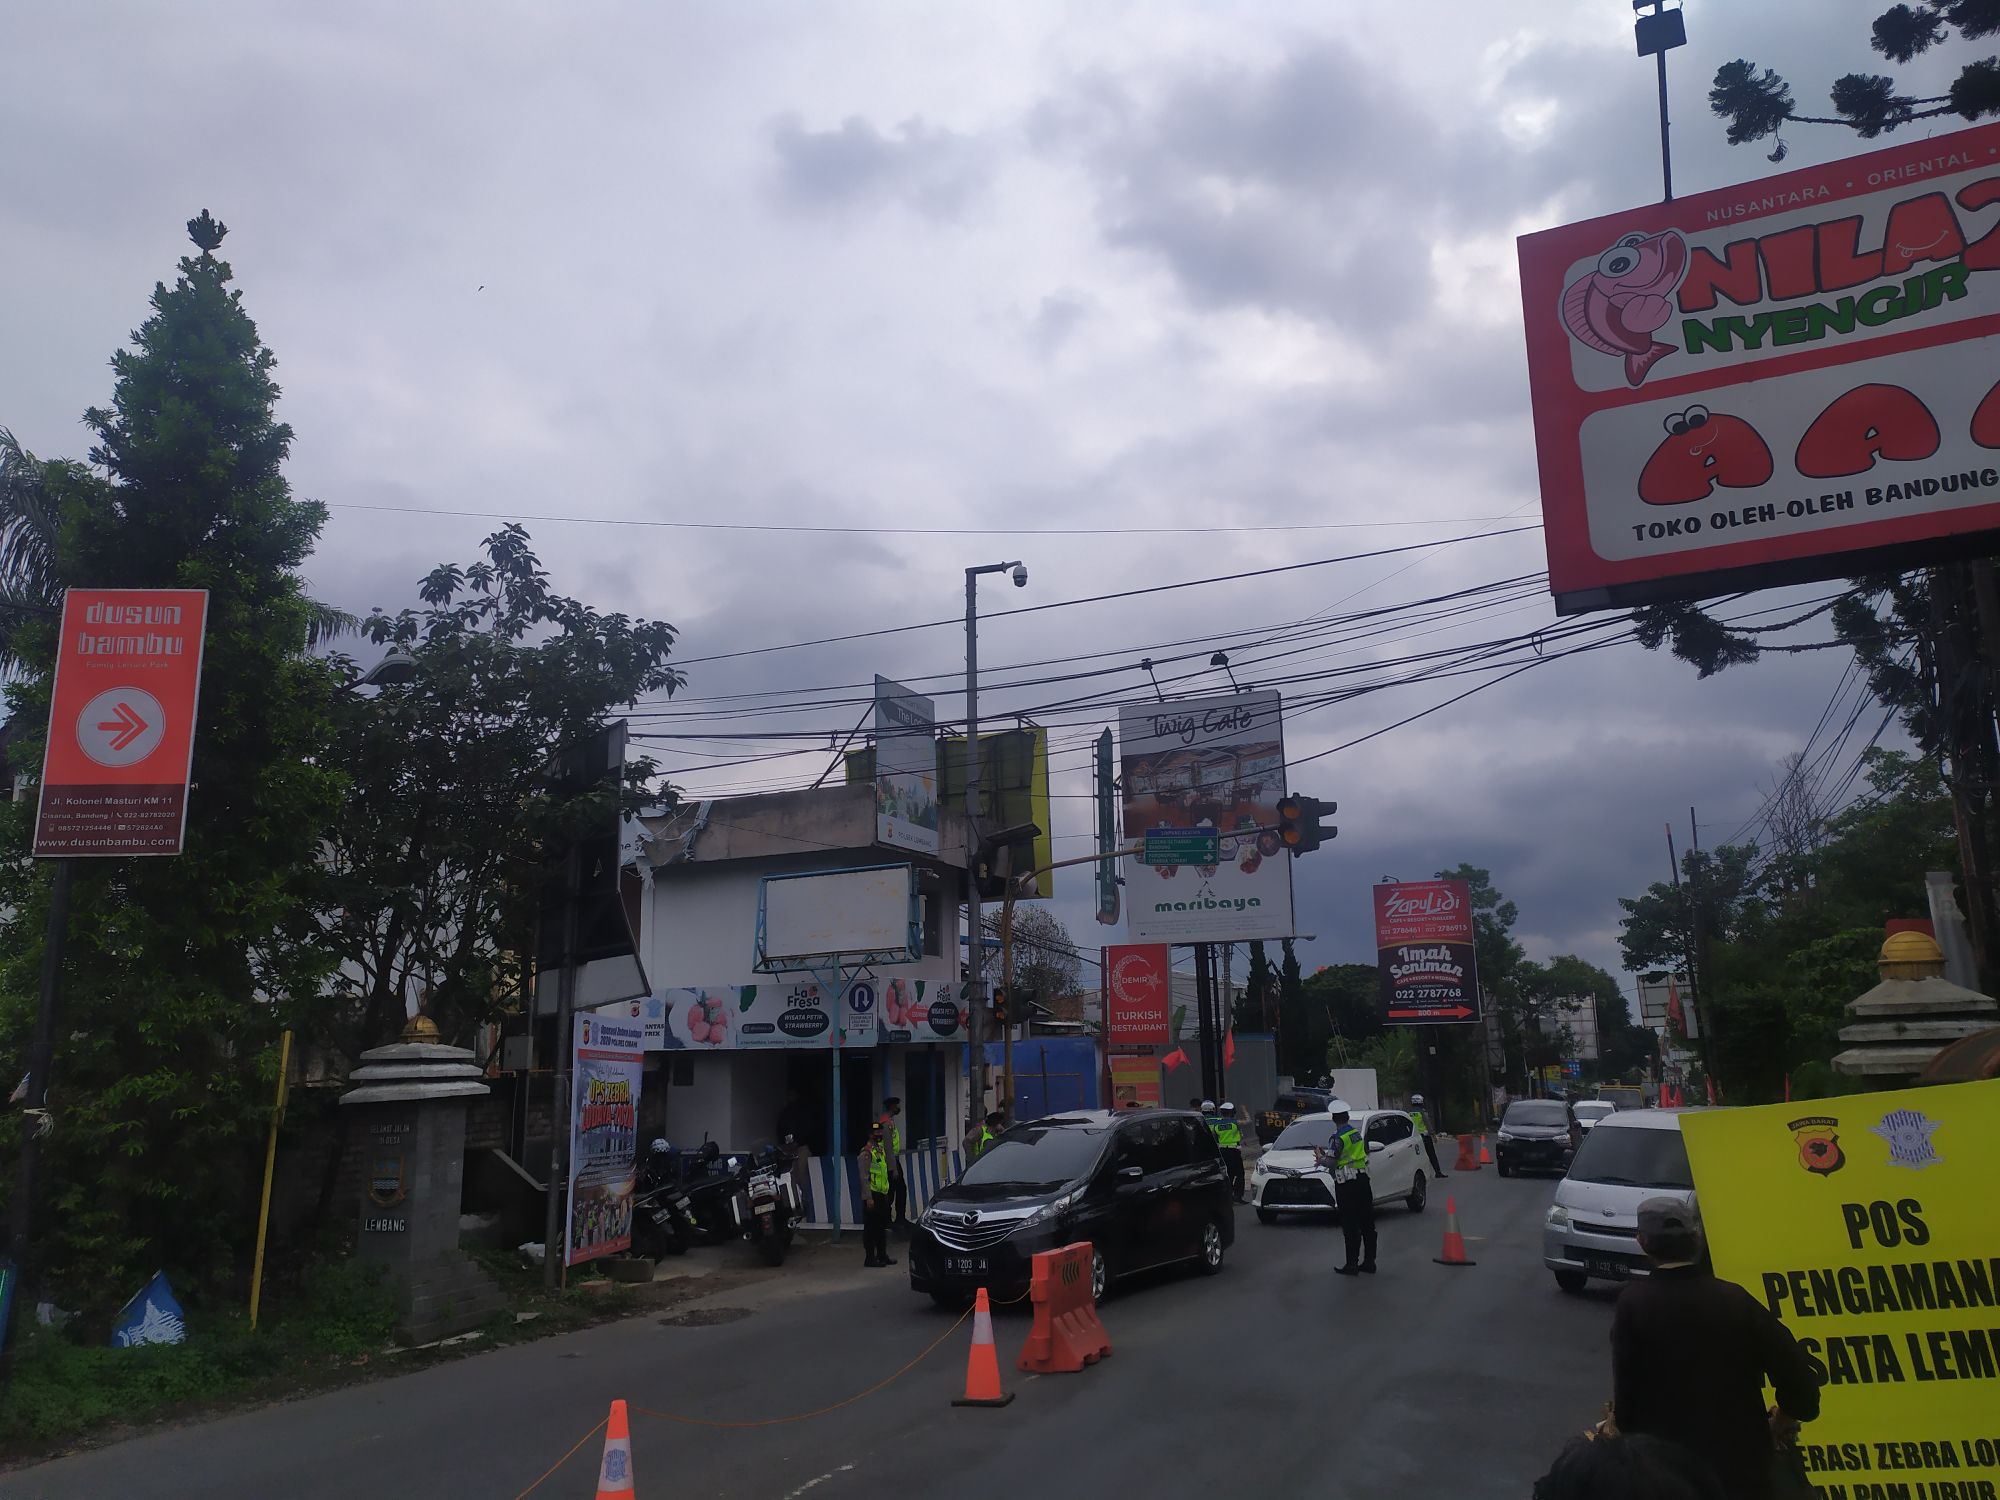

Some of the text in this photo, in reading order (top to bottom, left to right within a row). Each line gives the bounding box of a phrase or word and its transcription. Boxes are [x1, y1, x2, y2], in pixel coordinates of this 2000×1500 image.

[1706, 151, 1975, 222] NUSANTARA ORIENTAL
[1682, 262, 1970, 354] NYENGIR
[1632, 468, 2000, 542] TOKO OLEH-OLEH BANDUNG
[86, 601, 182, 625] dusun
[78, 631, 183, 656] bambu
[1147, 705, 1252, 744] Twig Cafe
[66, 797, 102, 805] Kolonel
[105, 797, 141, 805] Masturi
[38, 838, 176, 847] www.dusunbambu.com
[1155, 897, 1262, 912] maribaya
[1398, 945, 1452, 962] Imah
[1389, 959, 1463, 979] Seniman
[1121, 976, 1148, 984] DEMIR
[794, 986, 808, 998] La
[1396, 988, 1462, 999] 022 2787768
[787, 996, 820, 1009] Fresa
[1115, 1010, 1162, 1021] TURKISH
[1111, 1023, 1168, 1033] RESTAURANT
[600, 1035, 611, 1046] 2020
[590, 1077, 630, 1104] OPS ZEBRA
[1792, 1120, 1810, 1129] JAWA
[364, 1218, 406, 1232] LEMBANG
[1841, 1198, 1931, 1249] POS
[947, 1259, 952, 1269] B
[957, 1259, 973, 1269] 1203
[1905, 1328, 2000, 1381] LEM
[1873, 1440, 1961, 1470] ZEBRA
[1961, 1438, 2000, 1468] LO
